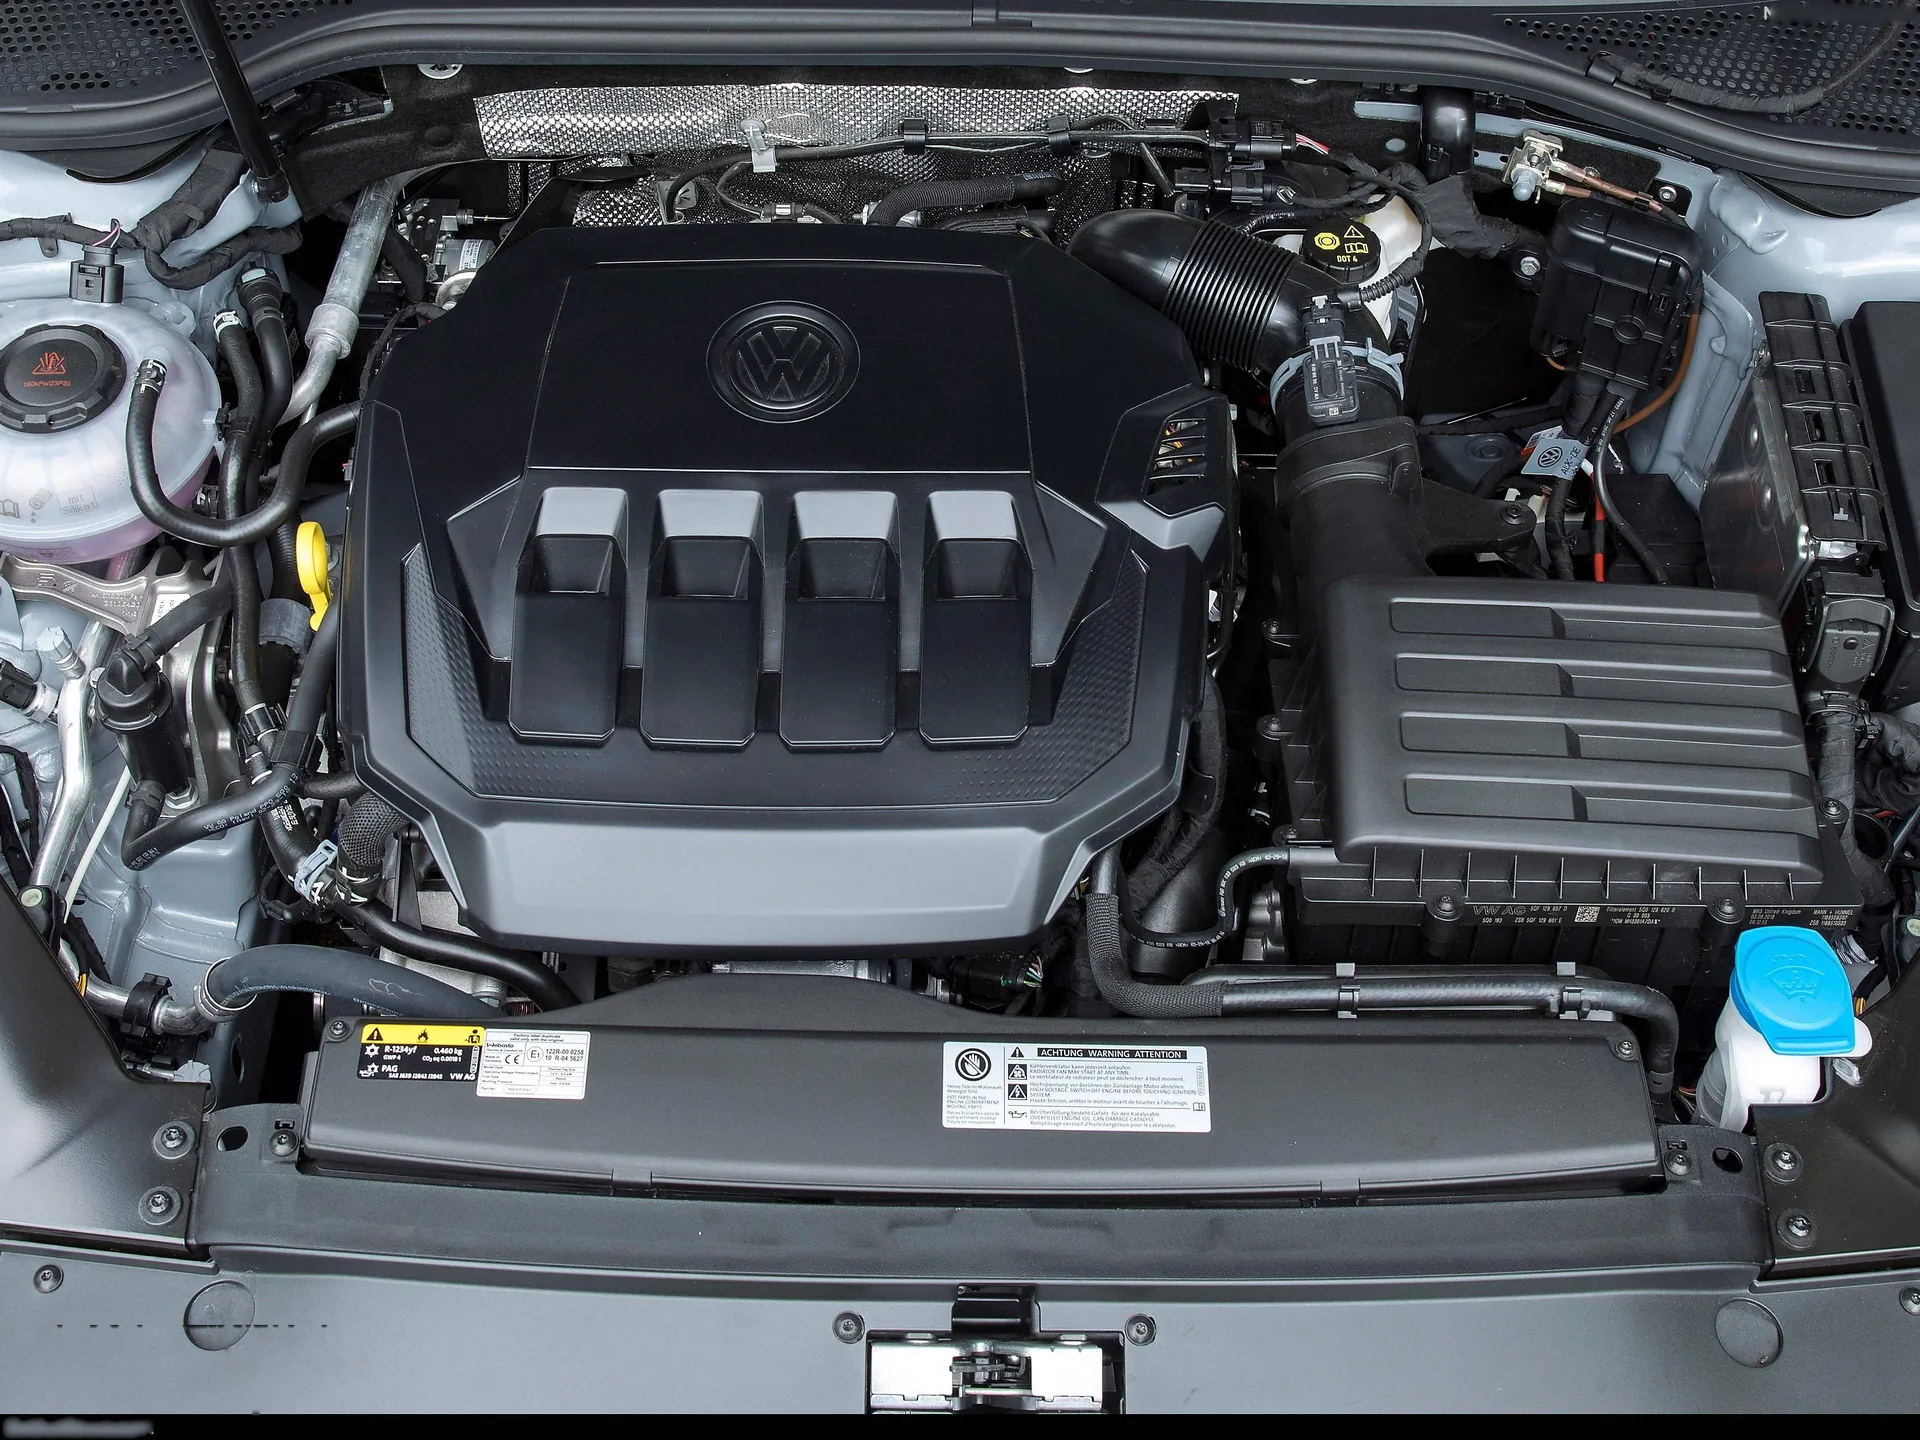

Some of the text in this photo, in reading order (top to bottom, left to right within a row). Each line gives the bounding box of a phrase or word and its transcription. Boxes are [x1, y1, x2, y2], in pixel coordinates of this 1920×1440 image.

[63, 502, 97, 515] Silikat
[1473, 906, 1526, 915] VW AG
[384, 1045, 417, 1055] R-1234yf
[1088, 1050, 1130, 1058] WARNING
